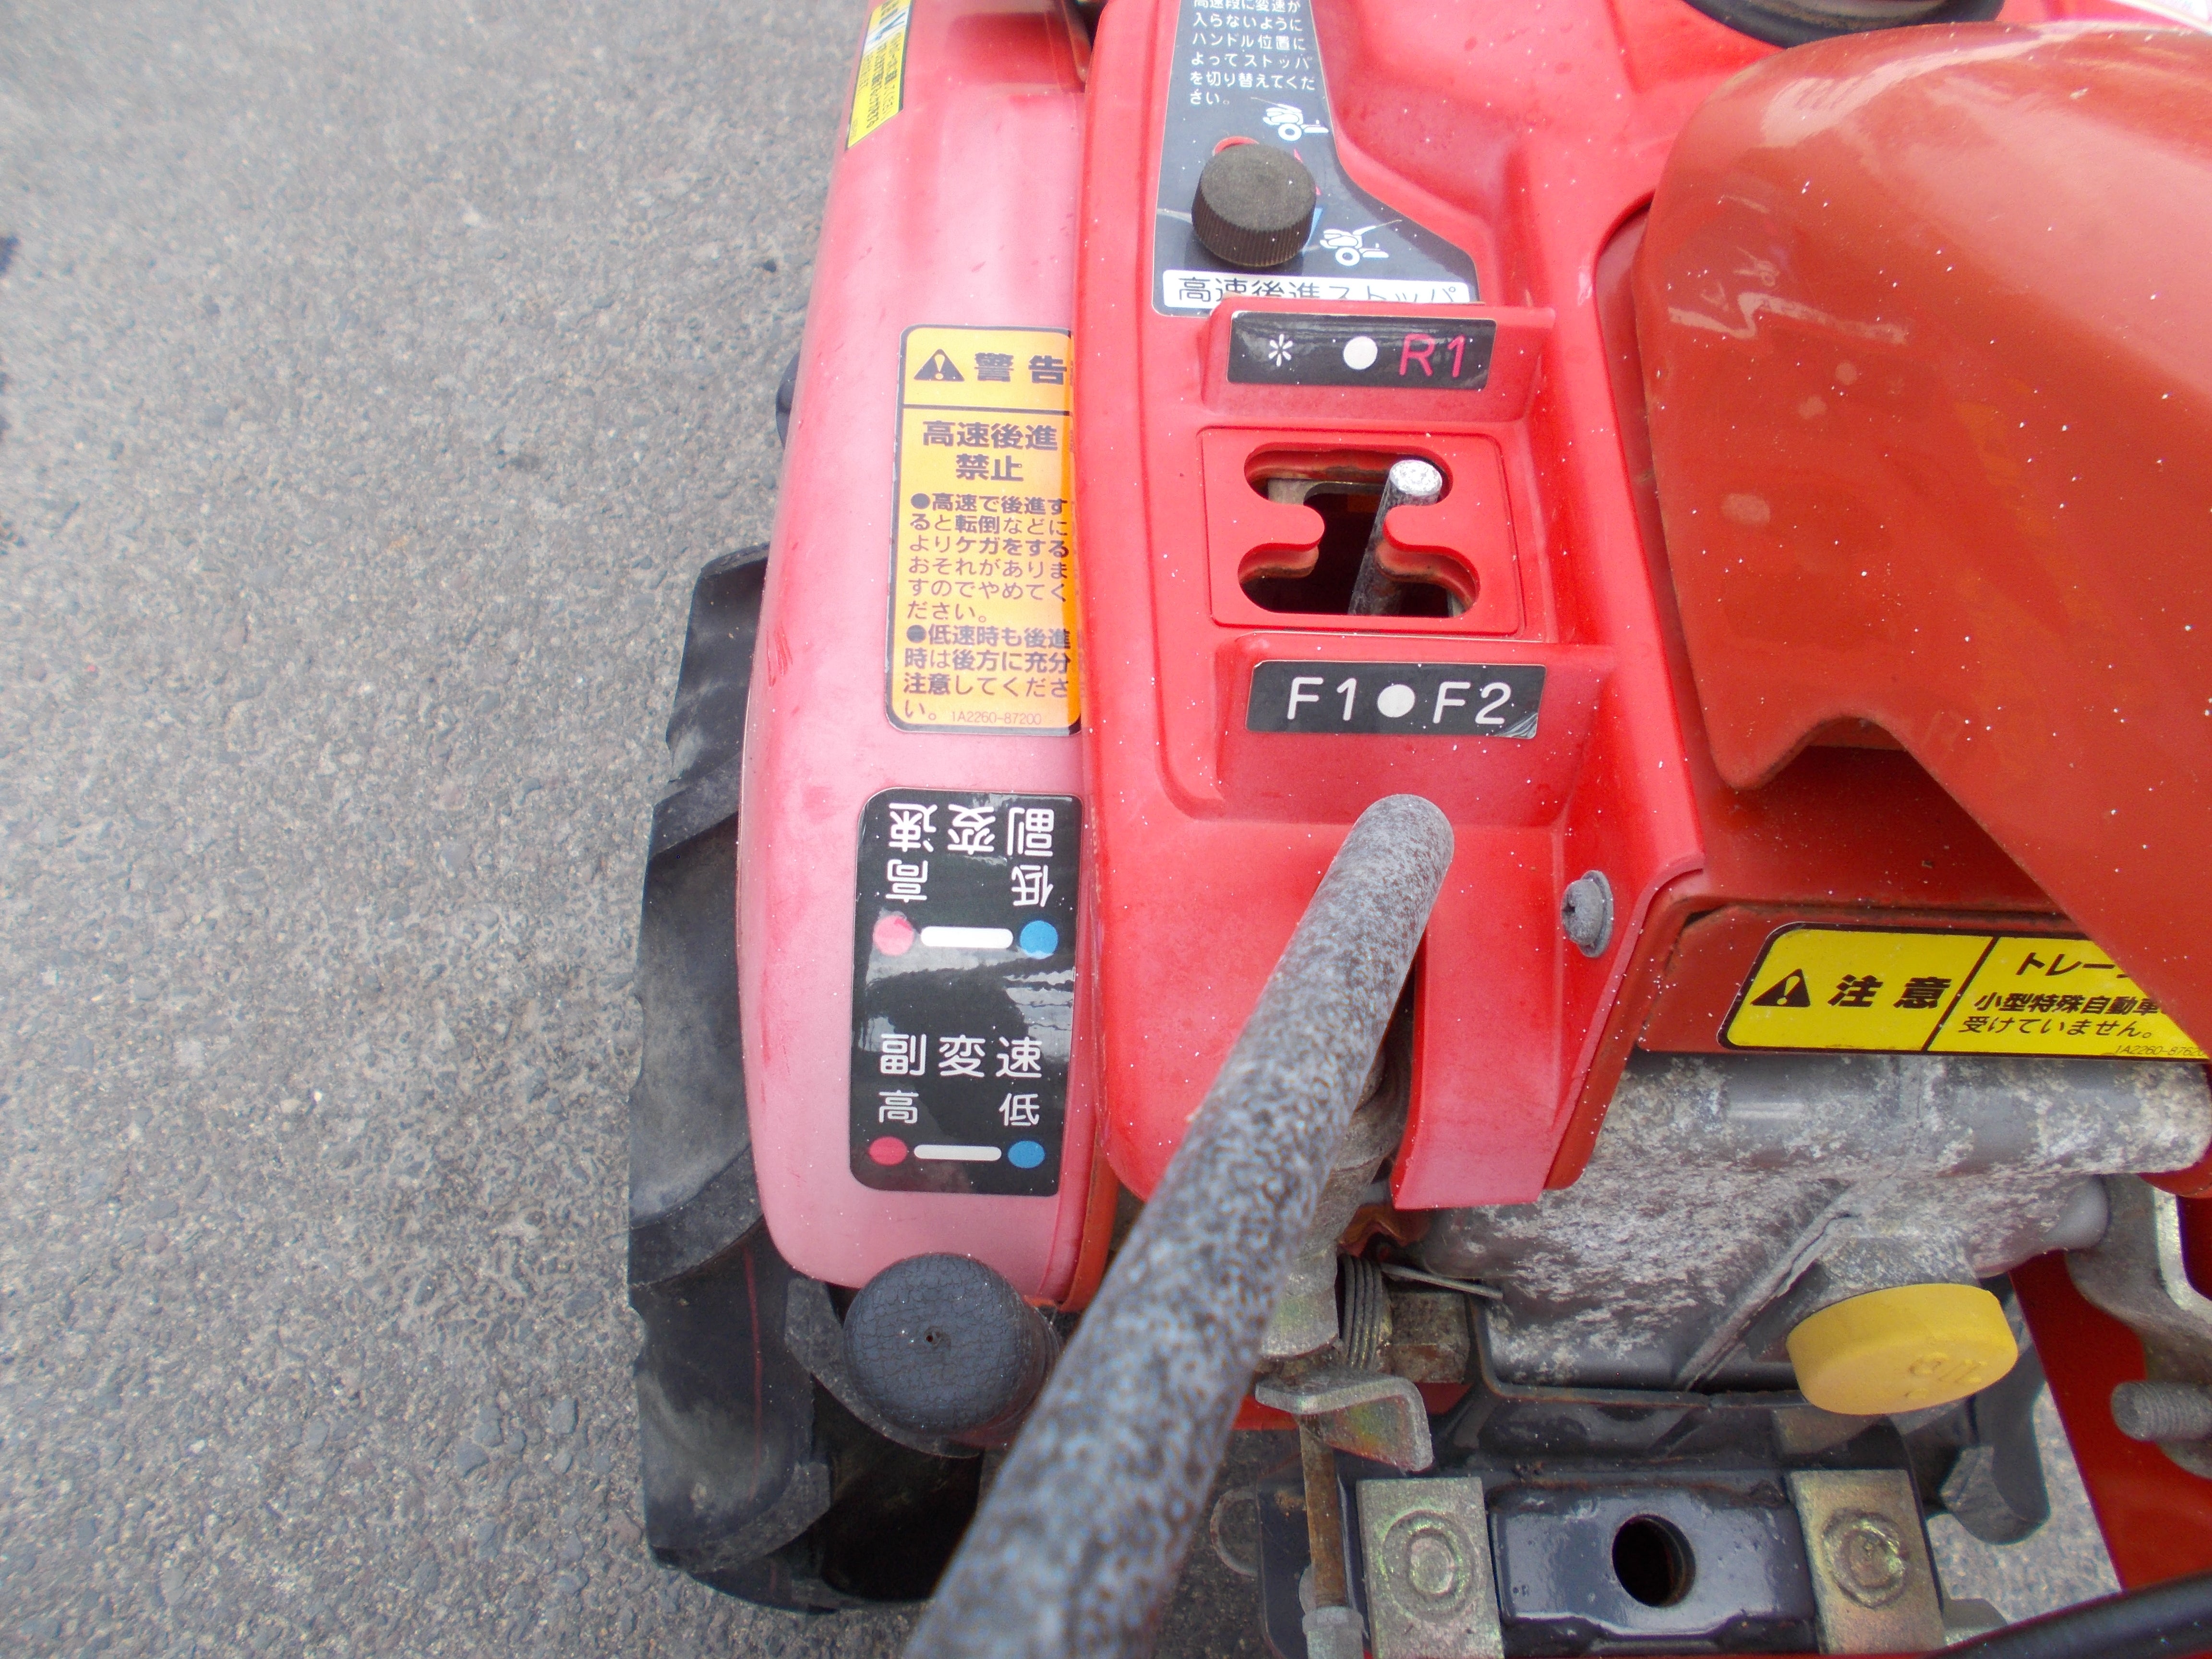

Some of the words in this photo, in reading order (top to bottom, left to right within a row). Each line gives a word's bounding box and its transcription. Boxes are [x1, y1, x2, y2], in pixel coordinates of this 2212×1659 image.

[1193, 12, 1303, 32] 入らないように
[1192, 32, 1306, 50] ハンドル位置に
[1191, 51, 1313, 69] よってストッパ
[1190, 71, 1316, 91] を切り替えてくだ
[1190, 89, 1230, 105] さい。
[1399, 333, 1467, 378] R1
[974, 352, 1068, 386] 警告
[922, 420, 1058, 451] 高速後進
[956, 453, 1024, 482] 禁止
[910, 513, 1069, 536] ると転倒などに
[909, 534, 1070, 558] よりケガをする
[908, 555, 1069, 580] おそれがありま
[908, 577, 1067, 603] すのでやめてく
[907, 600, 987, 623] ださい。
[905, 647, 1071, 674] 時は後方に充分
[903, 672, 1069, 698] 注意してくださ
[904, 699, 937, 721] い。
[1286, 676, 1357, 721] F1
[1433, 681, 1512, 725] F2
[951, 710, 1042, 726] 1A2260-87200
[885, 858, 928, 903] 高
[1010, 864, 1053, 907] 低
[2016, 951, 2129, 978] トレー
[1827, 974, 1952, 1010] 注意
[1959, 1016, 2152, 1038] 受けていません。
[879, 1033, 1042, 1079] 副変速
[878, 1090, 919, 1124] 高
[998, 1093, 1040, 1126] 低
